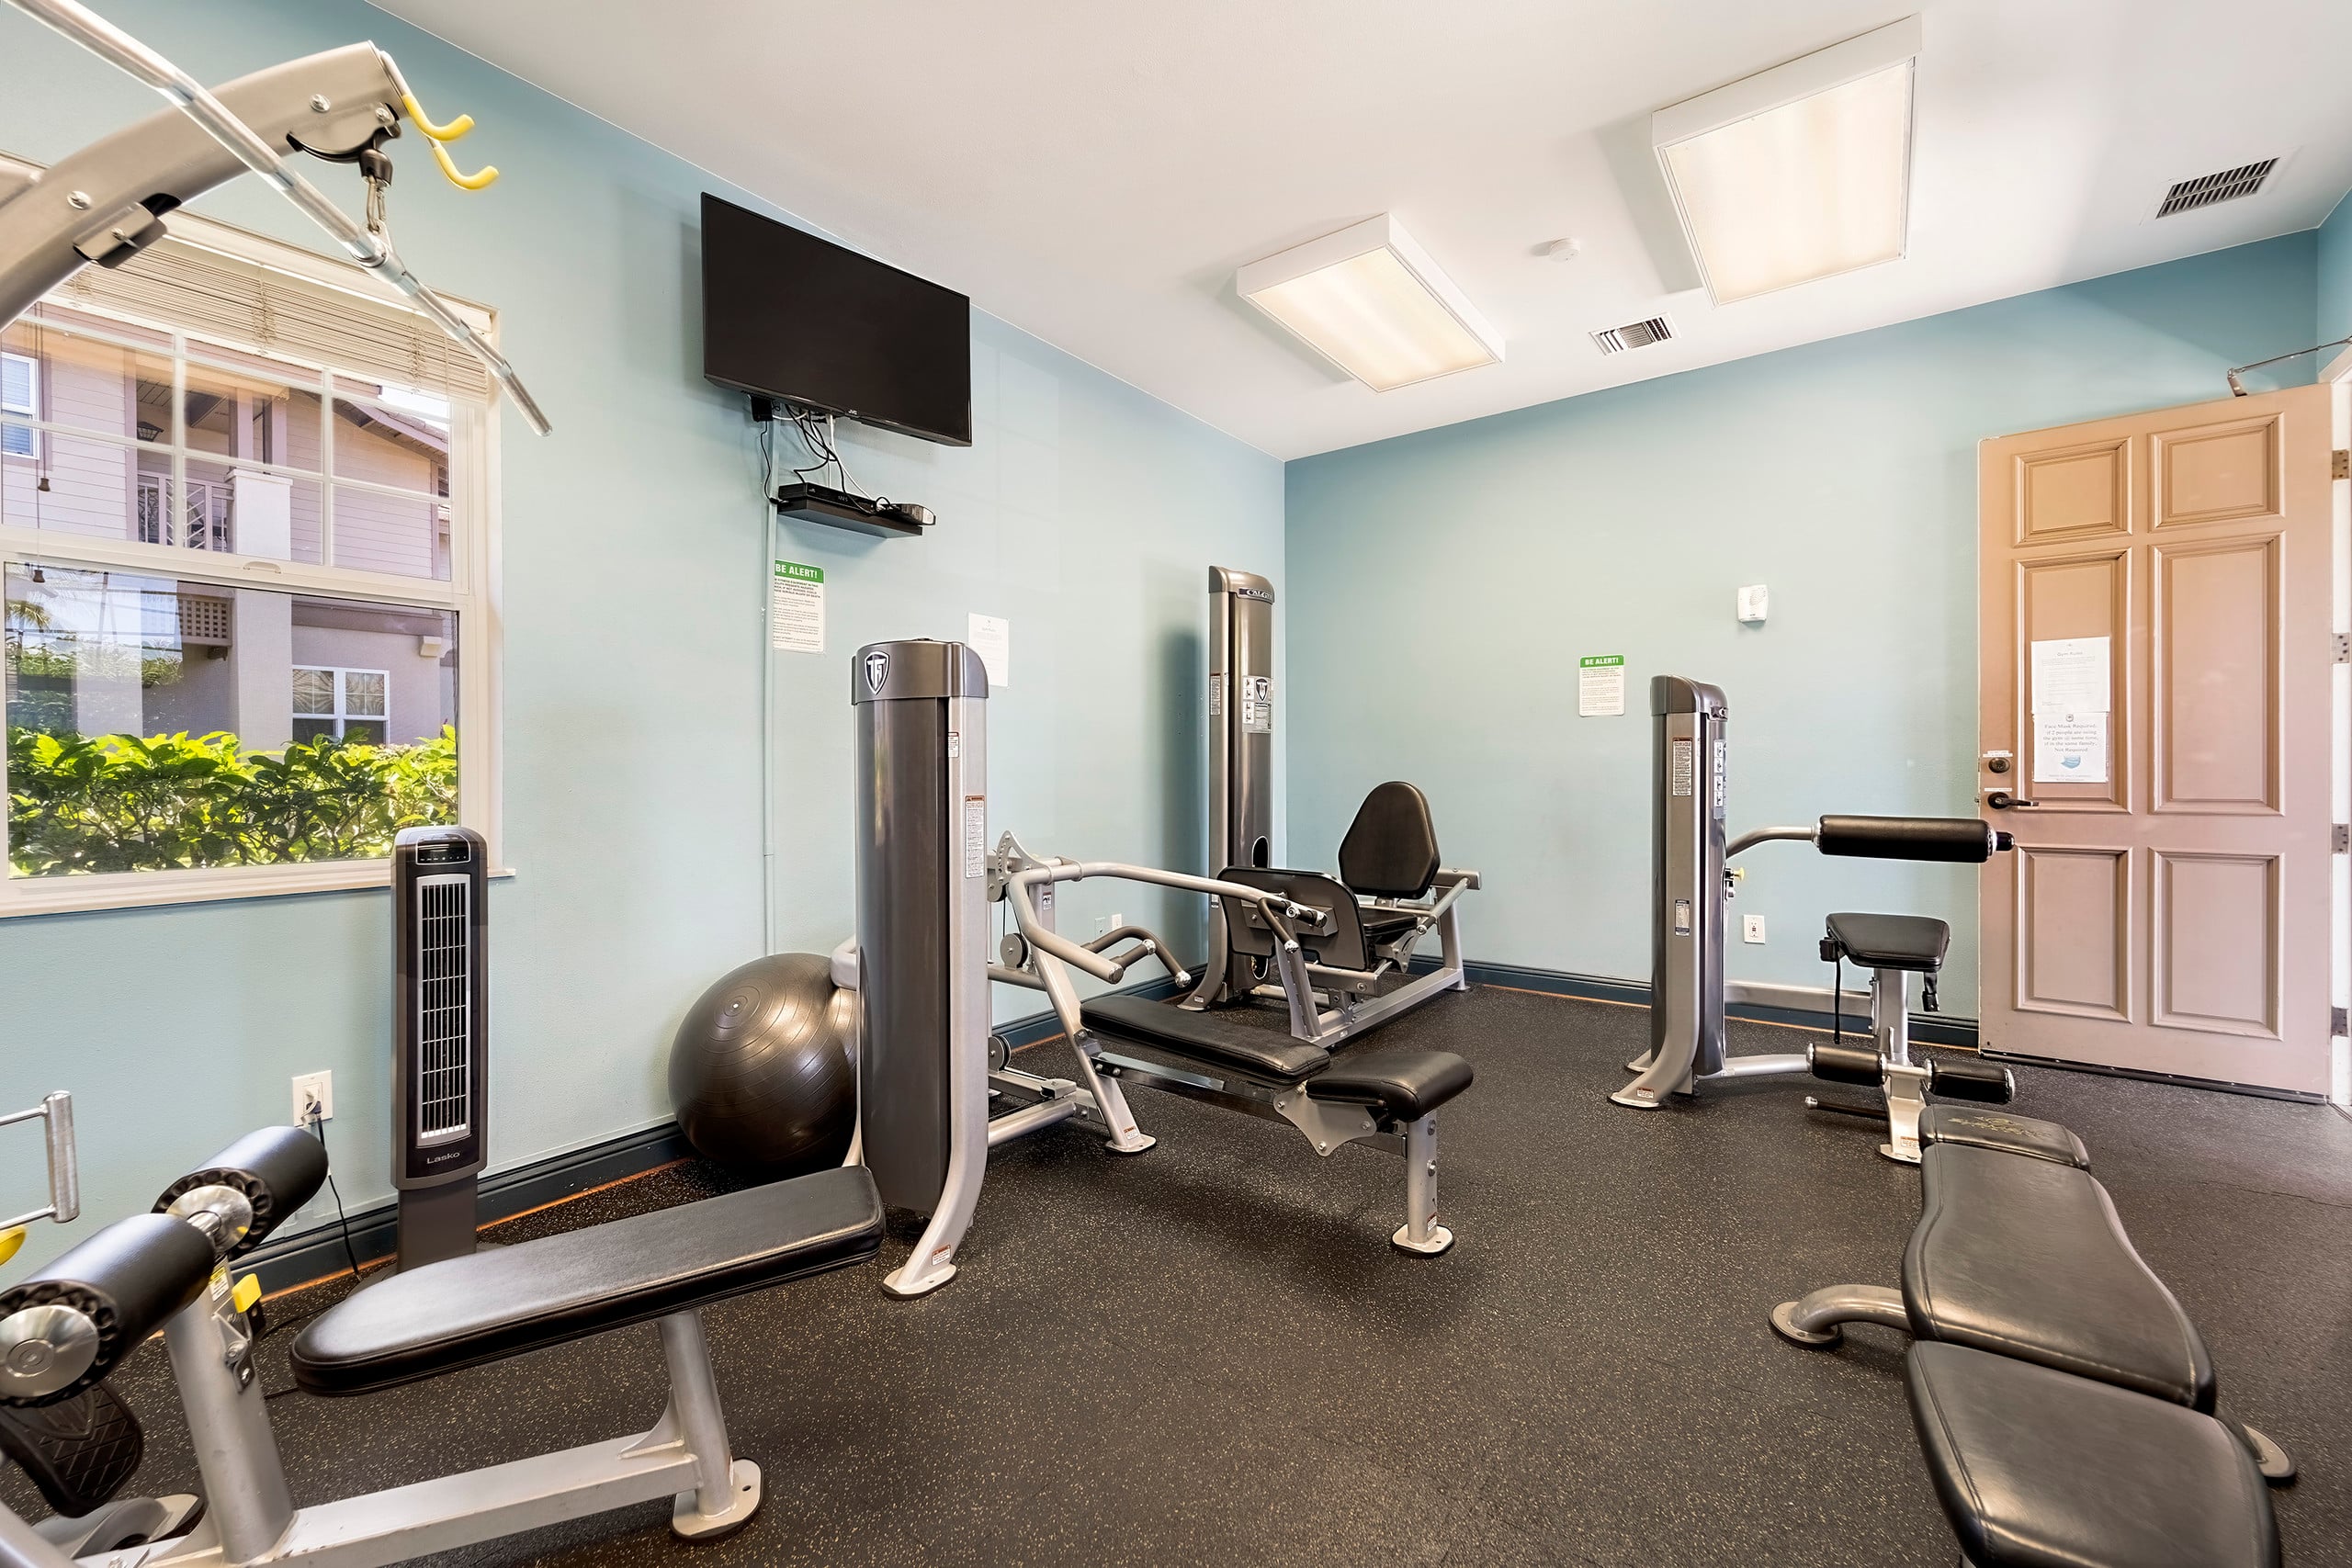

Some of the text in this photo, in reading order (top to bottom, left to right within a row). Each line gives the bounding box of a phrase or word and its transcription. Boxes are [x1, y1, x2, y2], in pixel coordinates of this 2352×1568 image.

[775, 563, 818, 579] BE ALERT!
[1595, 657, 1619, 665] ALERT!
[426, 1152, 460, 1164] Lasko
